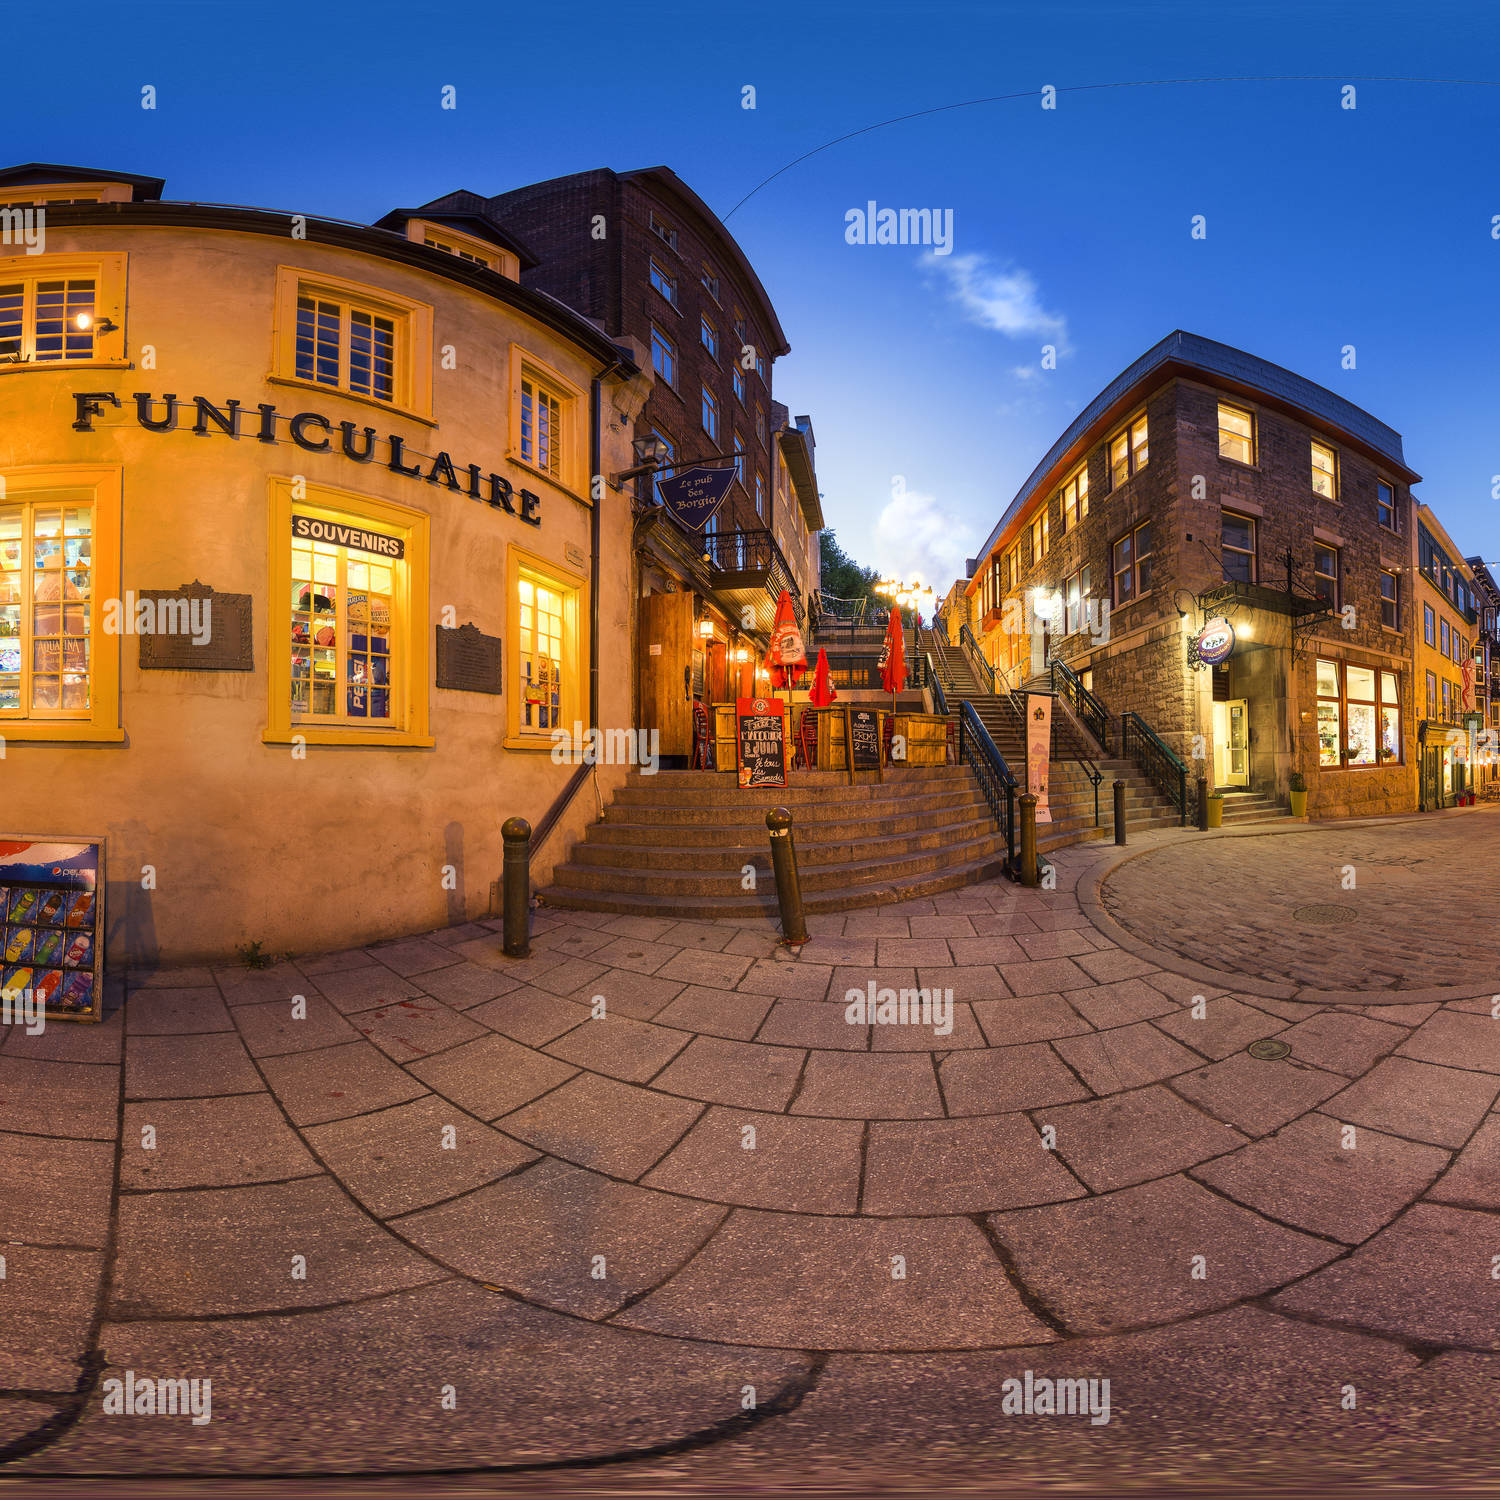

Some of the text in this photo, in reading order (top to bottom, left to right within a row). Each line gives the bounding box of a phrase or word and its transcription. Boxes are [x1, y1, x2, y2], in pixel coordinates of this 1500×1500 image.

[72, 391, 542, 526] FUNICULAIRE
[680, 474, 713, 489] Le pub
[688, 488, 704, 497] des
[675, 495, 717, 511] Borgia
[296, 518, 400, 556] SOUVENIRS
